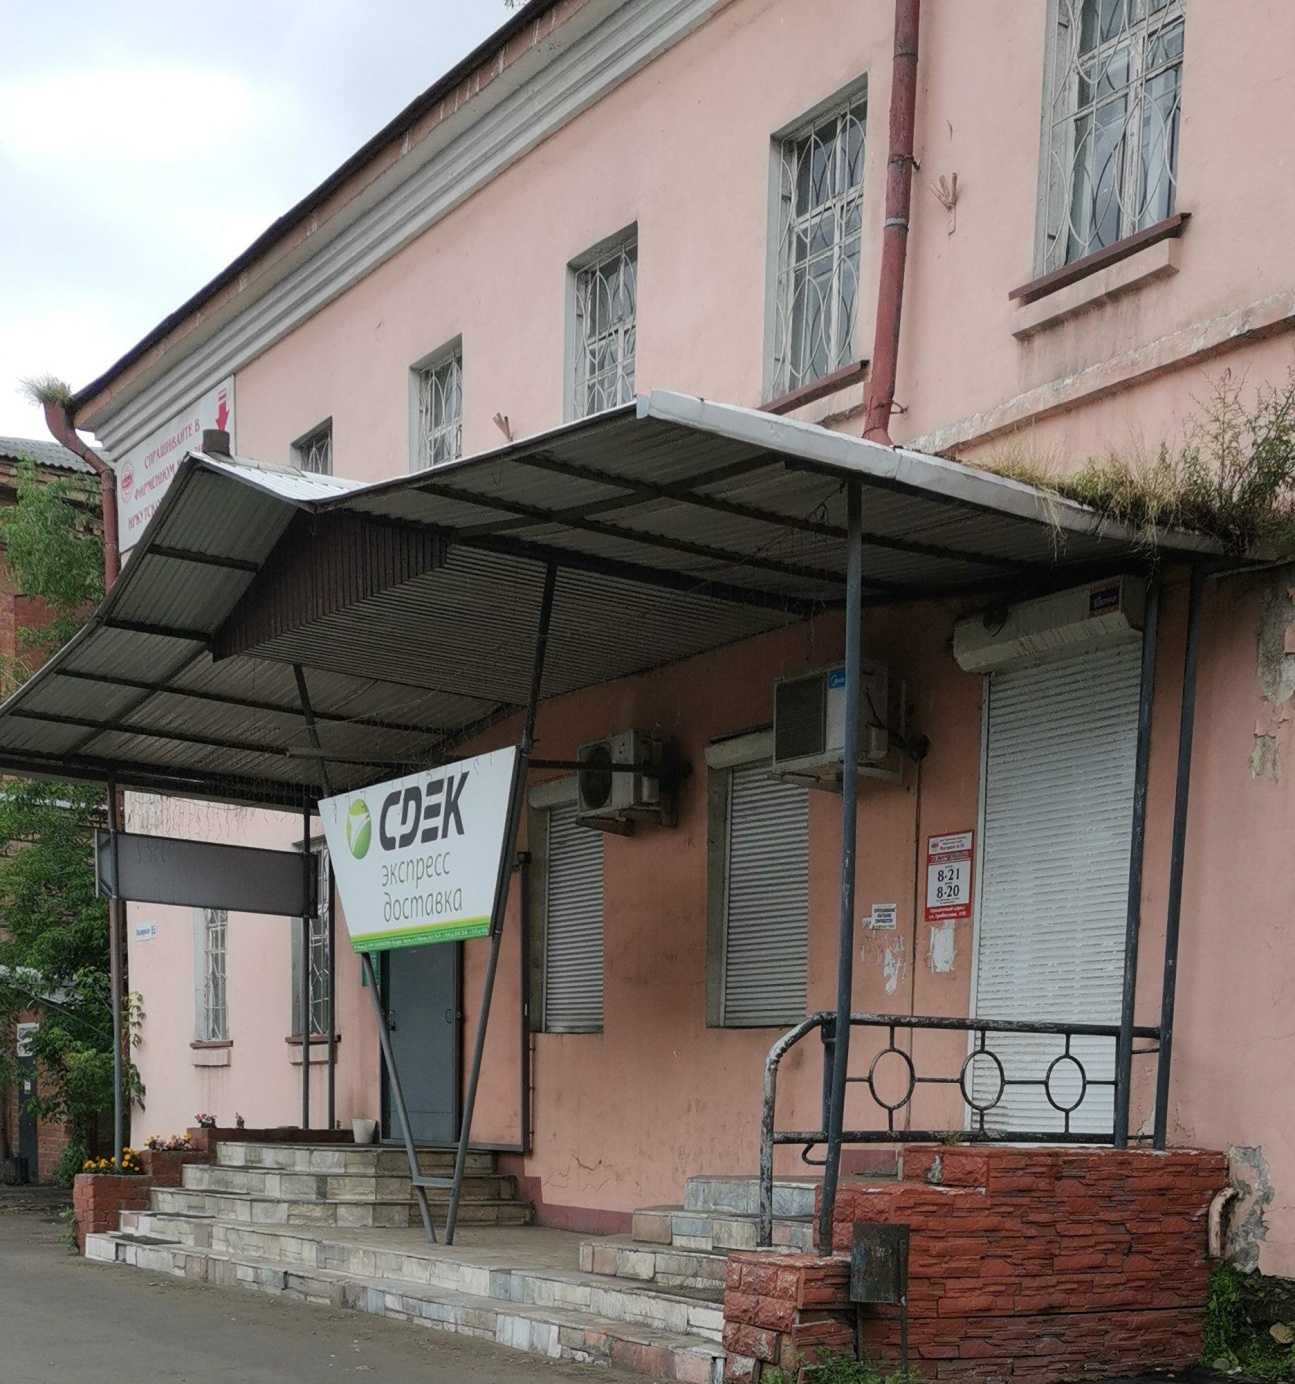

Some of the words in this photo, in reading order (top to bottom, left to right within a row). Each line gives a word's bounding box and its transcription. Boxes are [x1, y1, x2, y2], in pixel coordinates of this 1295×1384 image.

[379, 770, 470, 851] CDEK
[381, 851, 451, 889] экспресс
[383, 887, 463, 923] доставка
